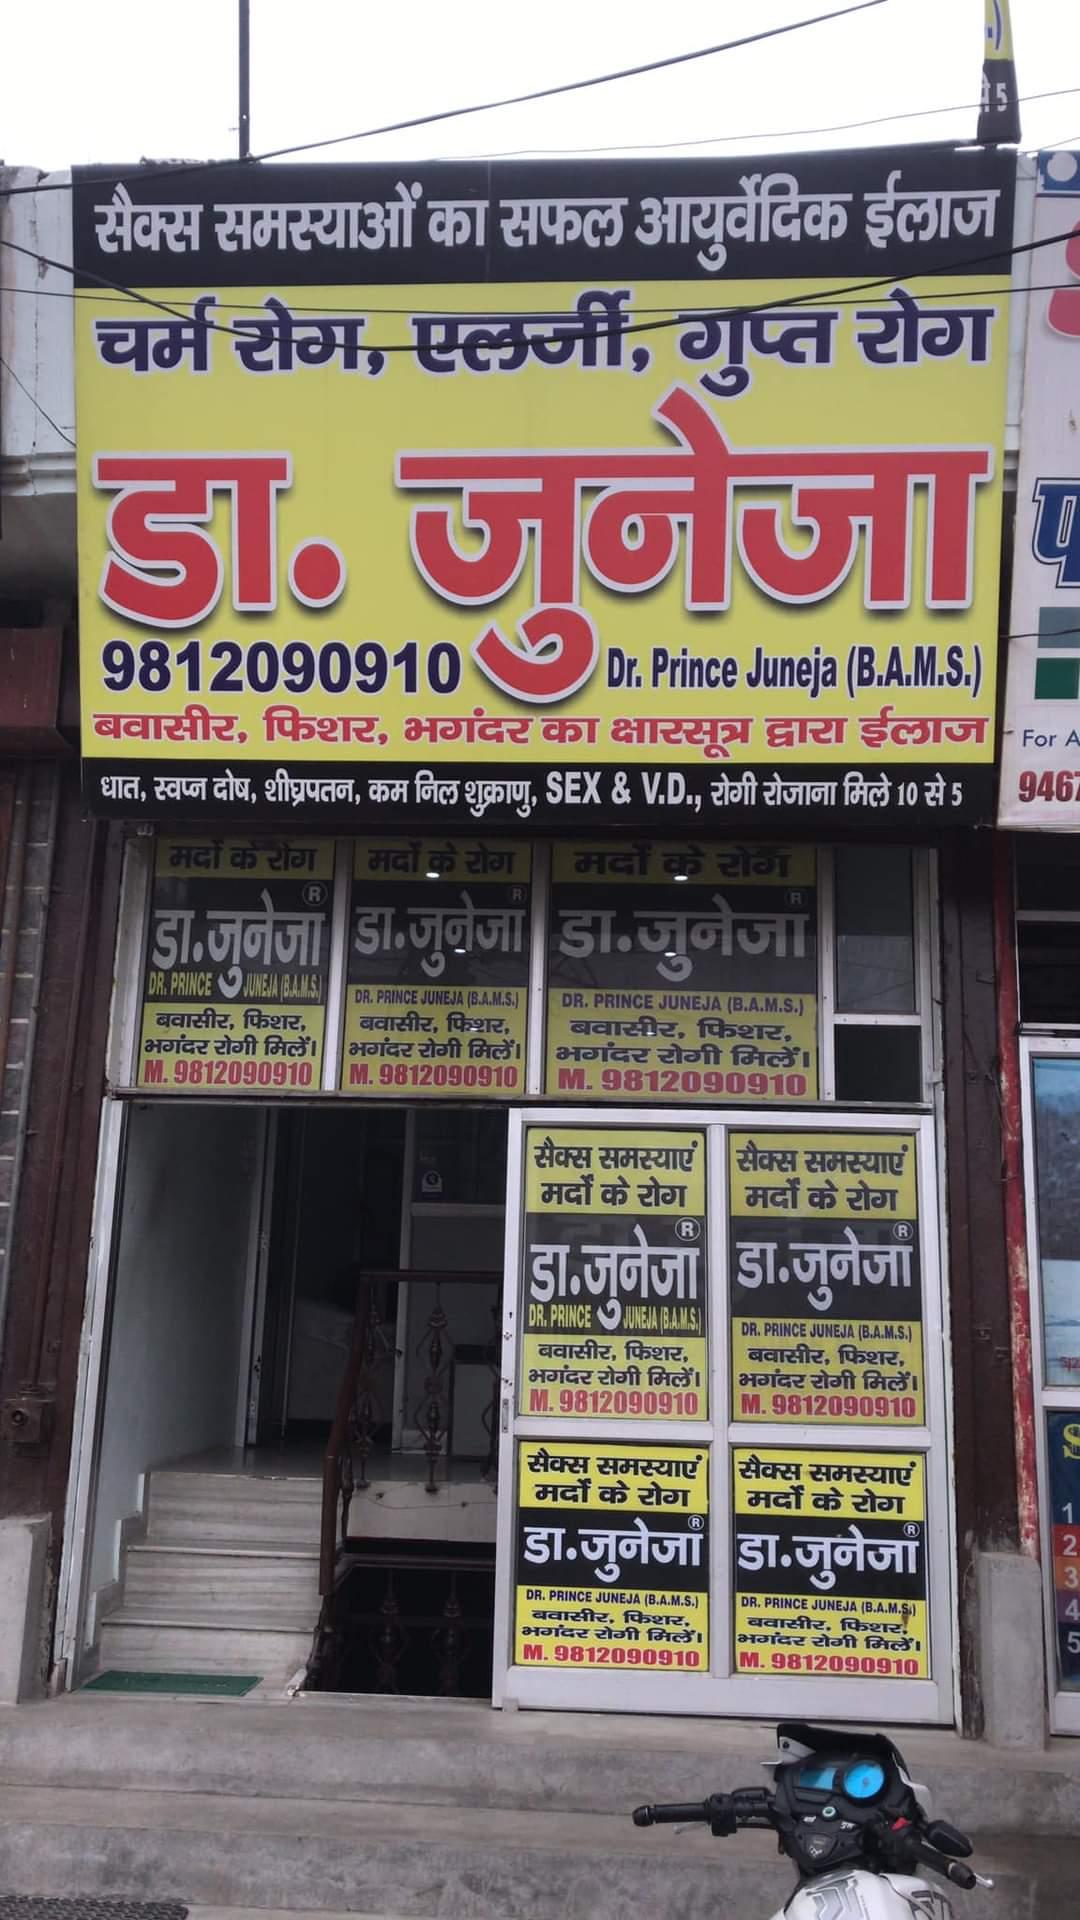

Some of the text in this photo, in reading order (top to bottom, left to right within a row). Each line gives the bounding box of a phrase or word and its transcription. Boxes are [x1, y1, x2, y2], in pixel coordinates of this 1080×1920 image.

[996, 82, 1008, 112] 5
[94, 170, 1001, 272] सैक्स समस्याओं का सफल आयुर्वेदिक ईलाज
[95, 287, 995, 397] चर्म रोग, एलर्जी, गुप्त रोग
[94, 454, 344, 627] डा.
[397, 383, 992, 699] जुनेजा
[102, 640, 462, 694] 9812090910
[606, 645, 983, 699] Dr. Prince Juneja (B.A.M.S.)
[92, 704, 990, 759] बवासीर, फिशर, भगंदर का क्षारसूत्र द्वारा ईलाज
[1022, 729, 1057, 747] For
[100, 768, 963, 818] धात, स्वप्न दोष, शीघ्रपतन, कम निल शुक्राणु, SEX & V.D., रोगी रोजाना मिले 10 से 5
[149, 971, 322, 1004] DR. PRINCE JUNEJA (B.A.M.S.)
[355, 989, 519, 1009] DR. PRINCE JUNEJA (B.A.M.S.)
[561, 992, 804, 1017] DR. PRINCE JUNEJA (B.A.M.S.)
[155, 1007, 306, 1032] बवासीर, फिशर,
[359, 1010, 511, 1036] बवासीर, फिशर,
[569, 1015, 793, 1042] बवासीर, फिशर,
[144, 1034, 210, 1056] भगंदर
[214, 1034, 259, 1057] रोगी
[348, 1036, 415, 1058] भगंदर
[417, 1037, 463, 1059] रोगी
[555, 1041, 652, 1063] भगंदर
[657, 1043, 724, 1066] रोगी
[143, 1059, 313, 1087] M. 9812090910
[349, 1063, 518, 1088] M. 9812090910
[557, 1068, 807, 1096] M. 9812090910
[533, 1135, 699, 1172] सैक्स समस्याएं
[735, 1139, 909, 1177] सैक्स समस्याएं
[540, 1174, 688, 1208] मर्दों के रोग
[744, 1177, 898, 1212] मर्दों के रोग
[528, 1303, 702, 1336] DR. PRINCE JUNEJA (B.A.M.S.)
[740, 1321, 913, 1343] DR. PRINCE JUNEJA (B.A.M.S.)
[538, 1338, 689, 1364] बवासीर, फिशर,
[747, 1343, 905, 1368] बवासीर, फिशर,
[528, 1364, 593, 1385] भगंदर
[597, 1366, 642, 1387] रोगी
[738, 1368, 807, 1389] भगंदर
[810, 1369, 857, 1391] रोगी
[529, 1388, 699, 1416] M. 9812090910
[740, 1392, 916, 1419] M. 9812090910
[526, 1447, 703, 1480] सैक्स समस्याएं
[737, 1453, 917, 1487] सैक्स समस्याएं
[533, 1478, 691, 1507] मर्दों के रोग
[746, 1484, 906, 1515] मर्दों के रोग
[1062, 1502, 1073, 1524] 1
[1062, 1534, 1077, 1556] 2
[1064, 1566, 1079, 1589] 3
[525, 1588, 699, 1609] DR. PRINCE JUNEJA (B.A.M.S.)
[740, 1596, 761, 1609] DR.
[764, 1597, 809, 1611] PRINCE
[811, 1598, 857, 1613] JUNEJA
[1065, 1598, 1080, 1621] 4
[521, 1624, 590, 1639] भगंदर
[594, 1625, 640, 1642] रोगी
[737, 1631, 805, 1648] भगंदर
[811, 1633, 859, 1650] रोगी
[1067, 1631, 1080, 1654] 5
[522, 1643, 700, 1668] M. 9812090910
[739, 1651, 919, 1676] M. 9812090910
